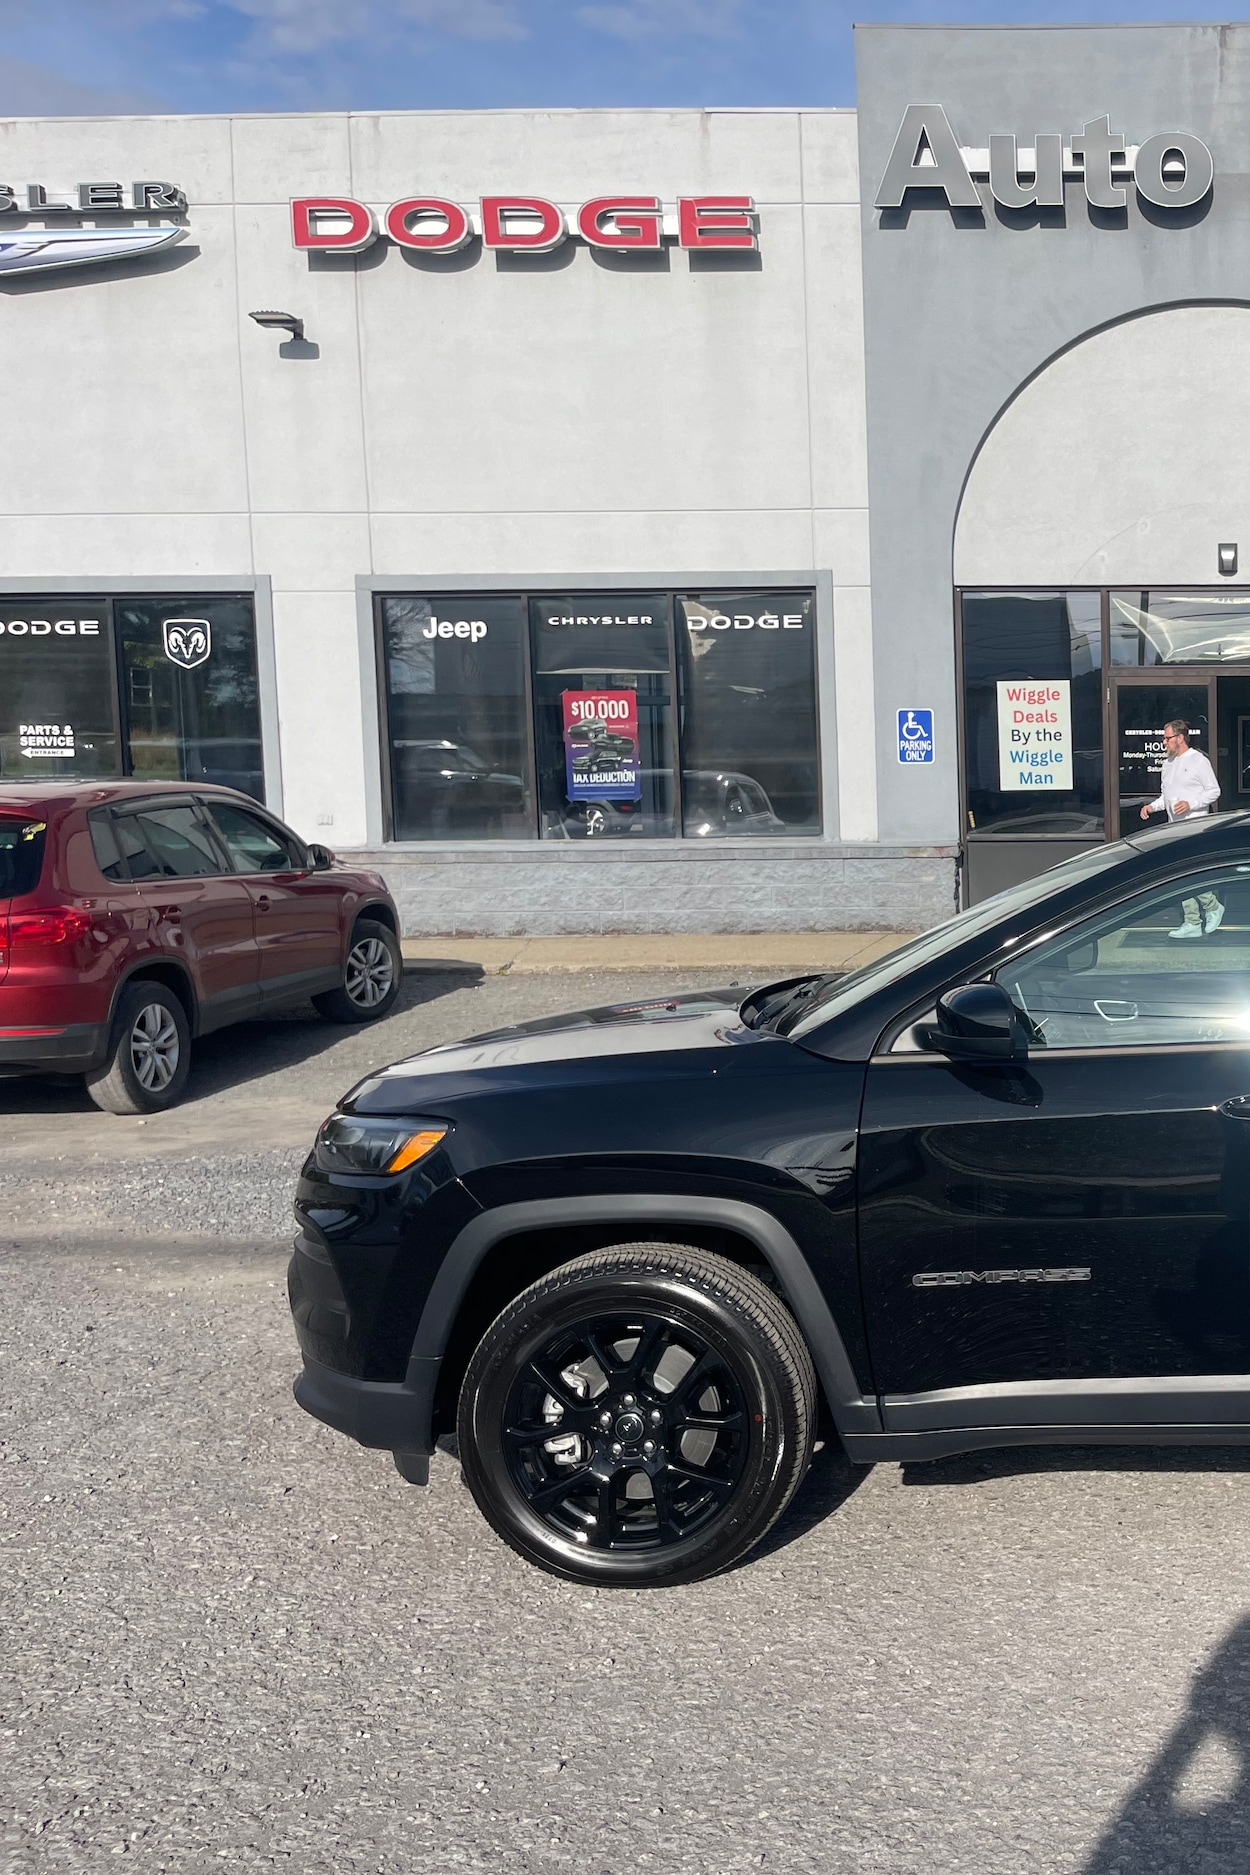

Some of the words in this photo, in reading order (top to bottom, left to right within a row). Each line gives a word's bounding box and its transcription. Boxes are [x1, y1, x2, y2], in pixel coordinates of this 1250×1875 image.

[873, 103, 1214, 208] Auto
[289, 195, 760, 253] DODGE
[0, 620, 100, 636] ODGE
[547, 614, 653, 626] CHRYSLER
[687, 614, 804, 630] DODGE
[422, 616, 488, 642] Jeep
[1006, 687, 1061, 705] Wiggle
[571, 699, 630, 720] $10,000
[1013, 709, 1058, 724] Deals
[19, 725, 61, 736] PARTS
[63, 725, 74, 736] &
[1011, 729, 1031, 746] By
[1035, 728, 1063, 742] the
[19, 736, 75, 747] SERVICE
[900, 740, 932, 751] PARKING
[1144, 742, 1168, 752] HOU
[905, 750, 927, 761] ONLY
[1009, 749, 1064, 767] Wiggle
[590, 769, 636, 784] DEDUCTION
[1019, 772, 1054, 785] Man
[911, 1266, 1092, 1288] COMPASS
